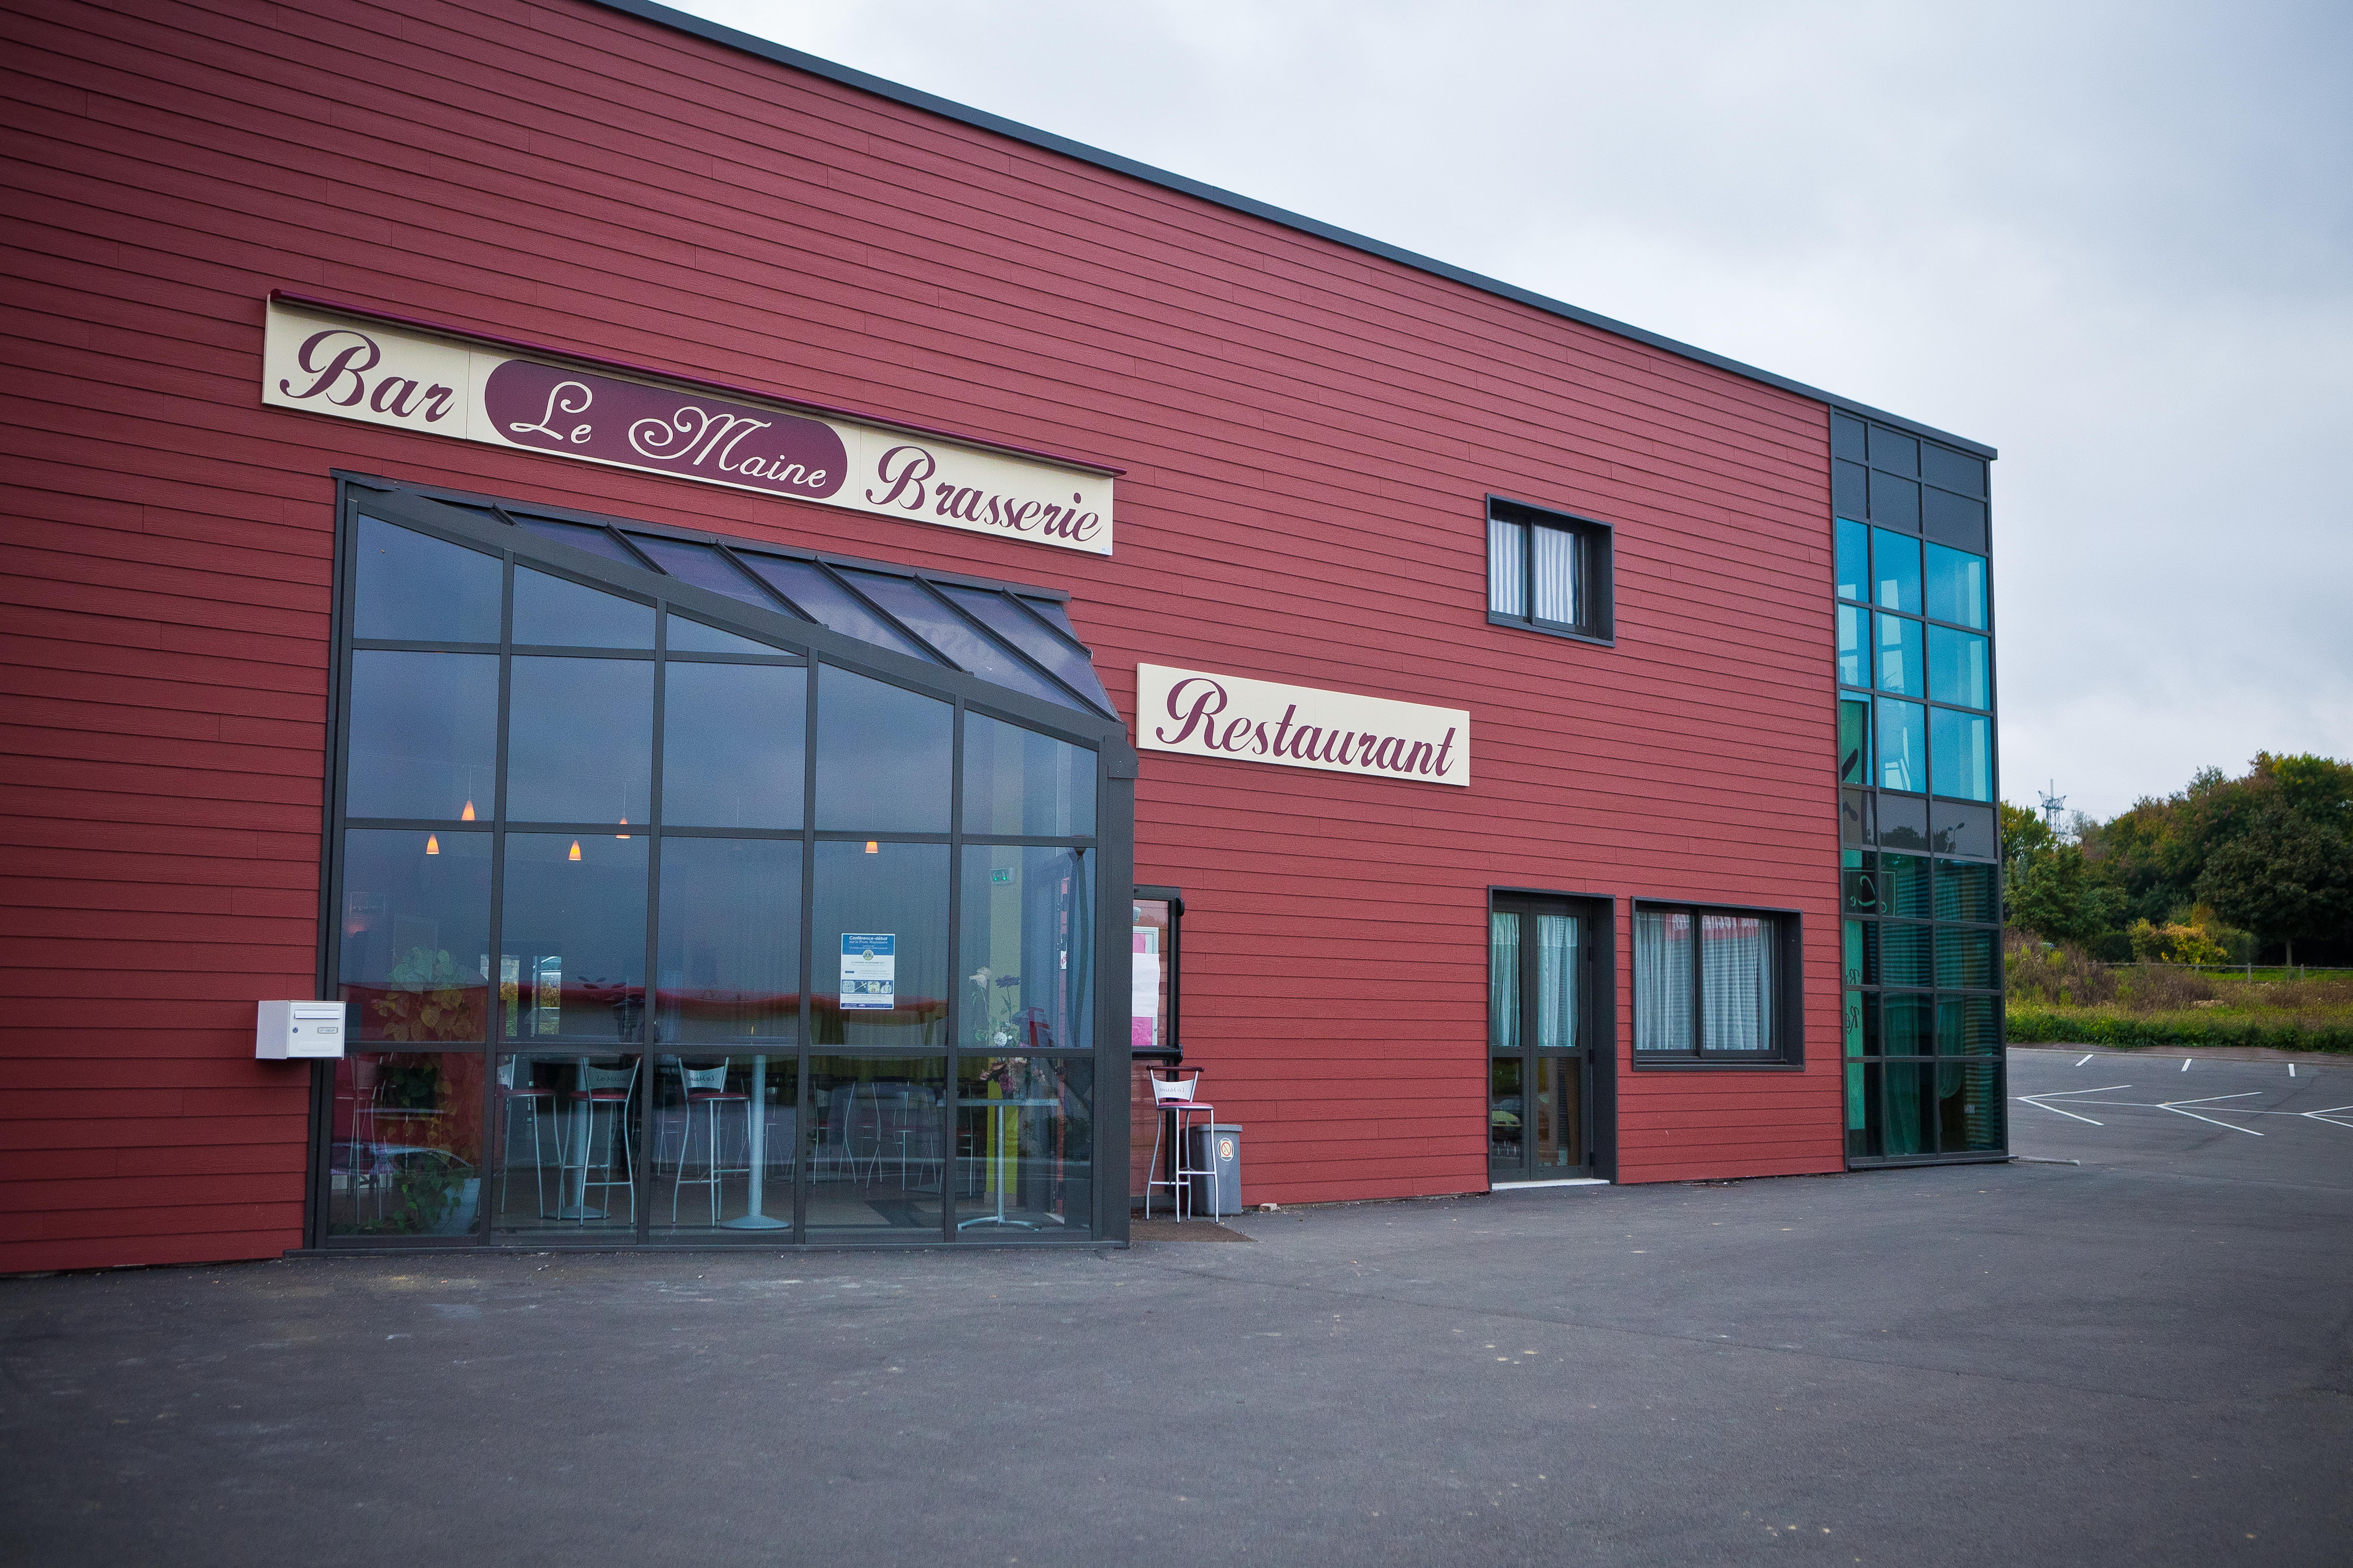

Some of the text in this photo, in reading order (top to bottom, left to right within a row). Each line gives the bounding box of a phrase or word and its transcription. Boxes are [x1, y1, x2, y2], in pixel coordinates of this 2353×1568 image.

[279, 329, 453, 423] Bar
[510, 381, 827, 488] Le Maine
[865, 446, 1102, 542] Brasserie
[1156, 678, 1455, 777] Restaurant
